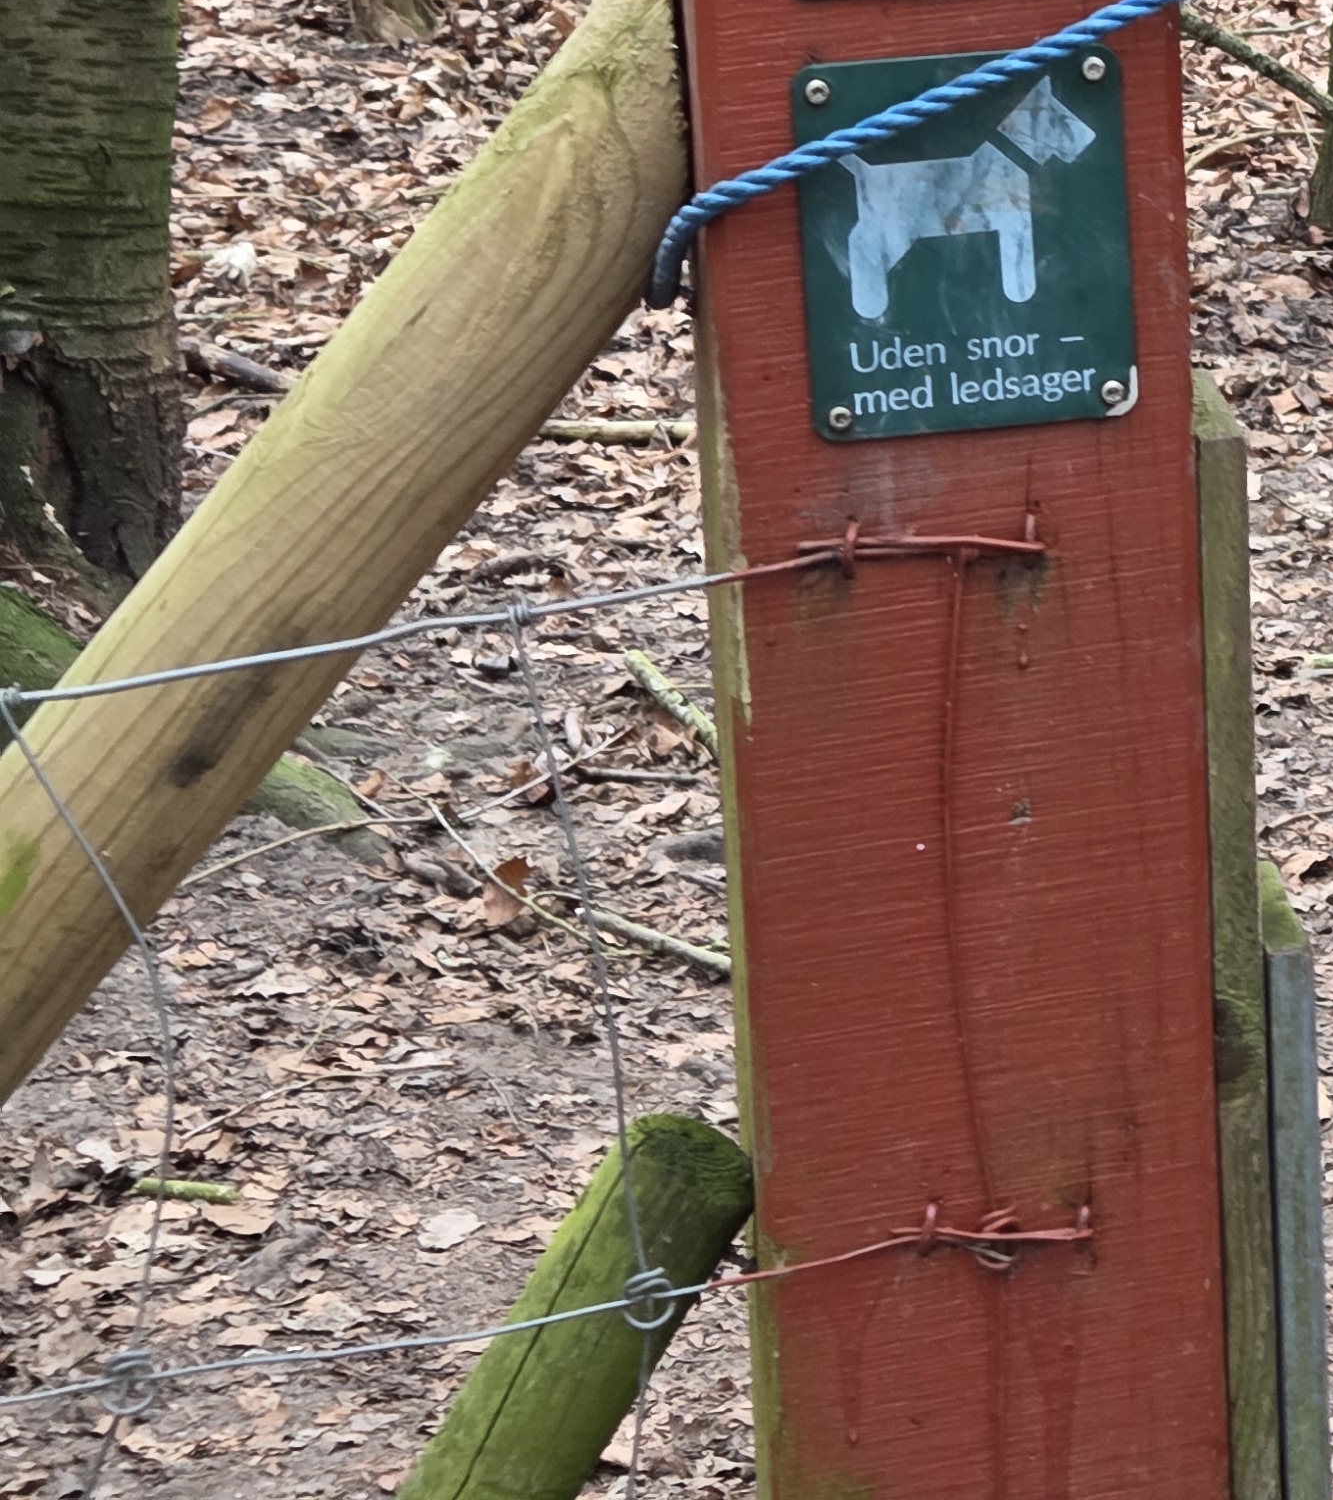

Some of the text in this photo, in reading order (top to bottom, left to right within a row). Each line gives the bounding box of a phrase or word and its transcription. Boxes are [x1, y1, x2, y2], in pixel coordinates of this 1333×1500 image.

[850, 337, 947, 373] Uden
[967, 333, 1040, 361] snor
[853, 367, 1097, 416] med ledsager
